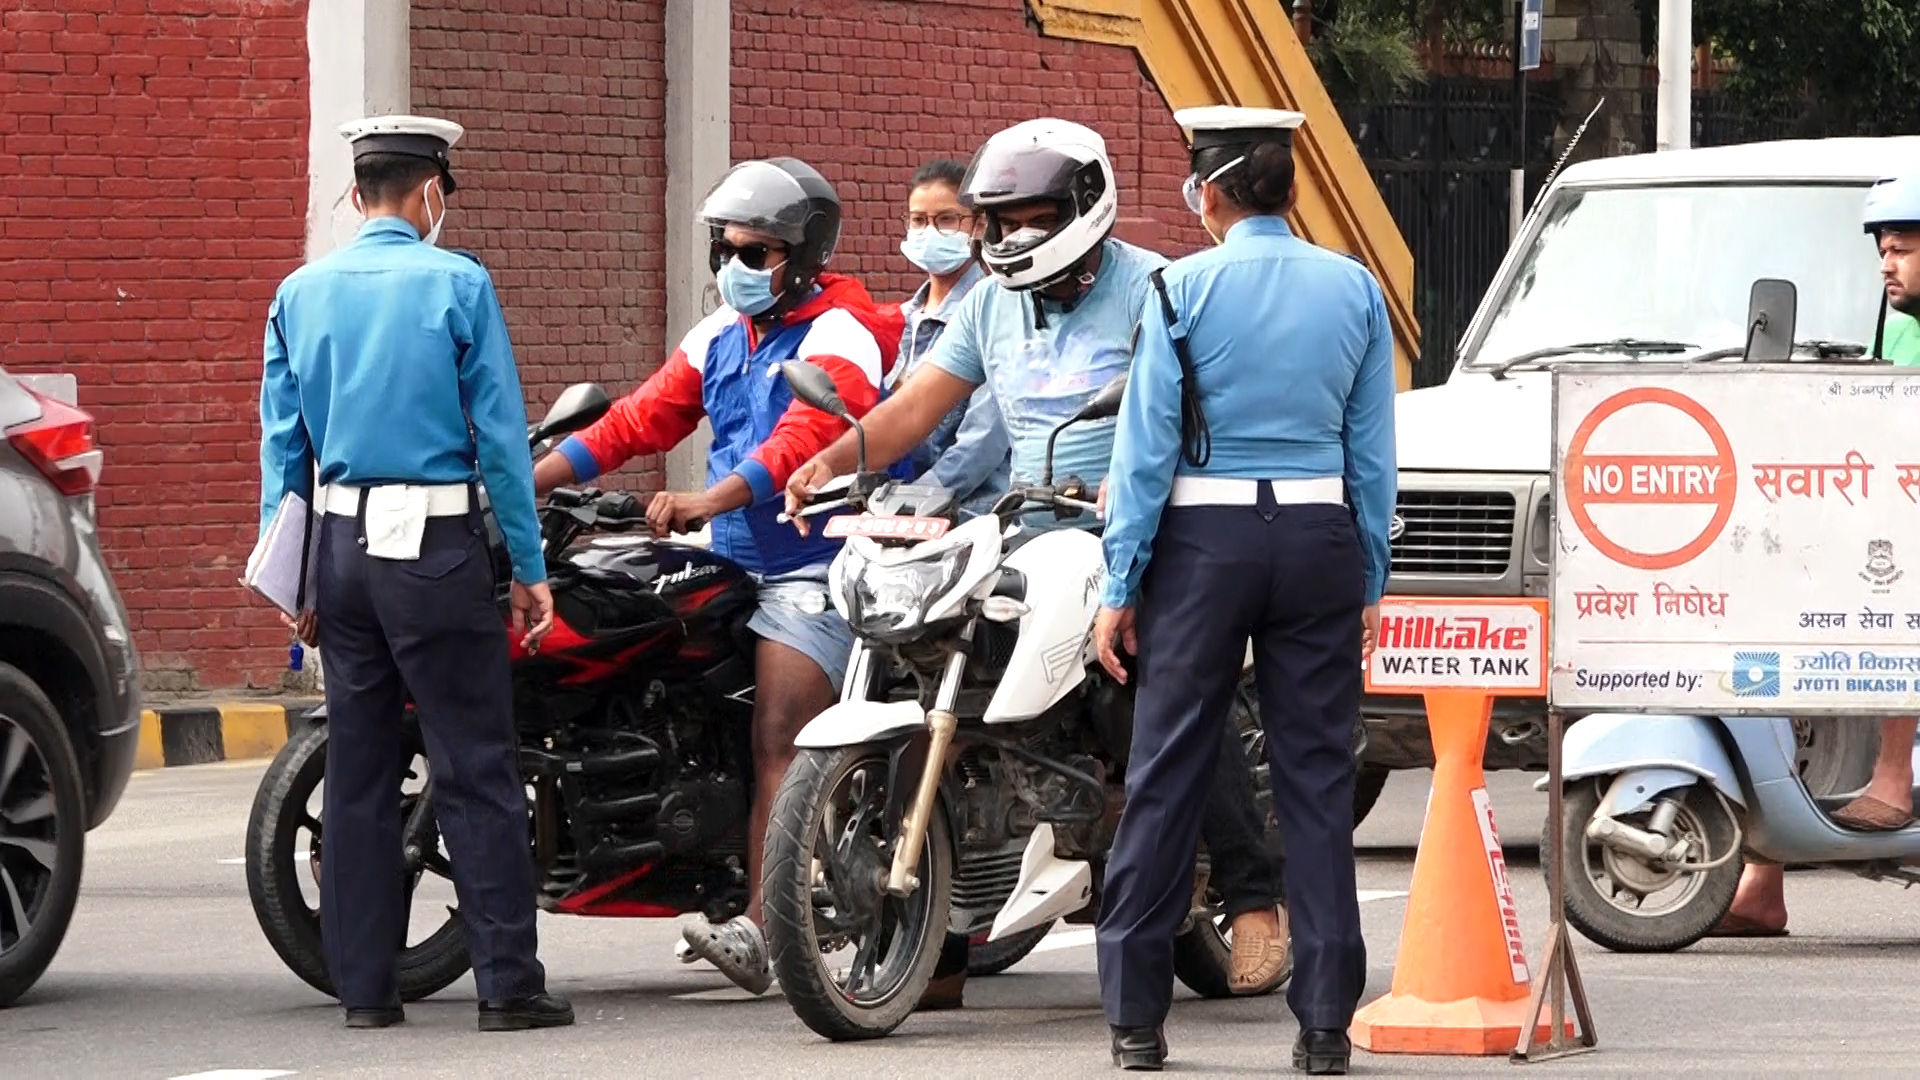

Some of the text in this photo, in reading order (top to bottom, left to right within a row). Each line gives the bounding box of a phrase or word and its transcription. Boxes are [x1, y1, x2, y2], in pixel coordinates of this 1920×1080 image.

[1583, 464, 1721, 495] NO ENTRY
[1752, 449, 1875, 507] सवारी
[1574, 583, 1639, 619] प्रवेश
[1799, 611, 1848, 629] असन
[1858, 605, 1894, 630] सेवा
[1378, 615, 1528, 651] Hilltake
[1382, 655, 1530, 676] WATER TANK
[1793, 651, 1851, 672] ज्योति
[1576, 668, 1703, 691] Supported by:
[1793, 678, 1840, 692] JYOTI
[1846, 678, 1907, 692] BIKASH
